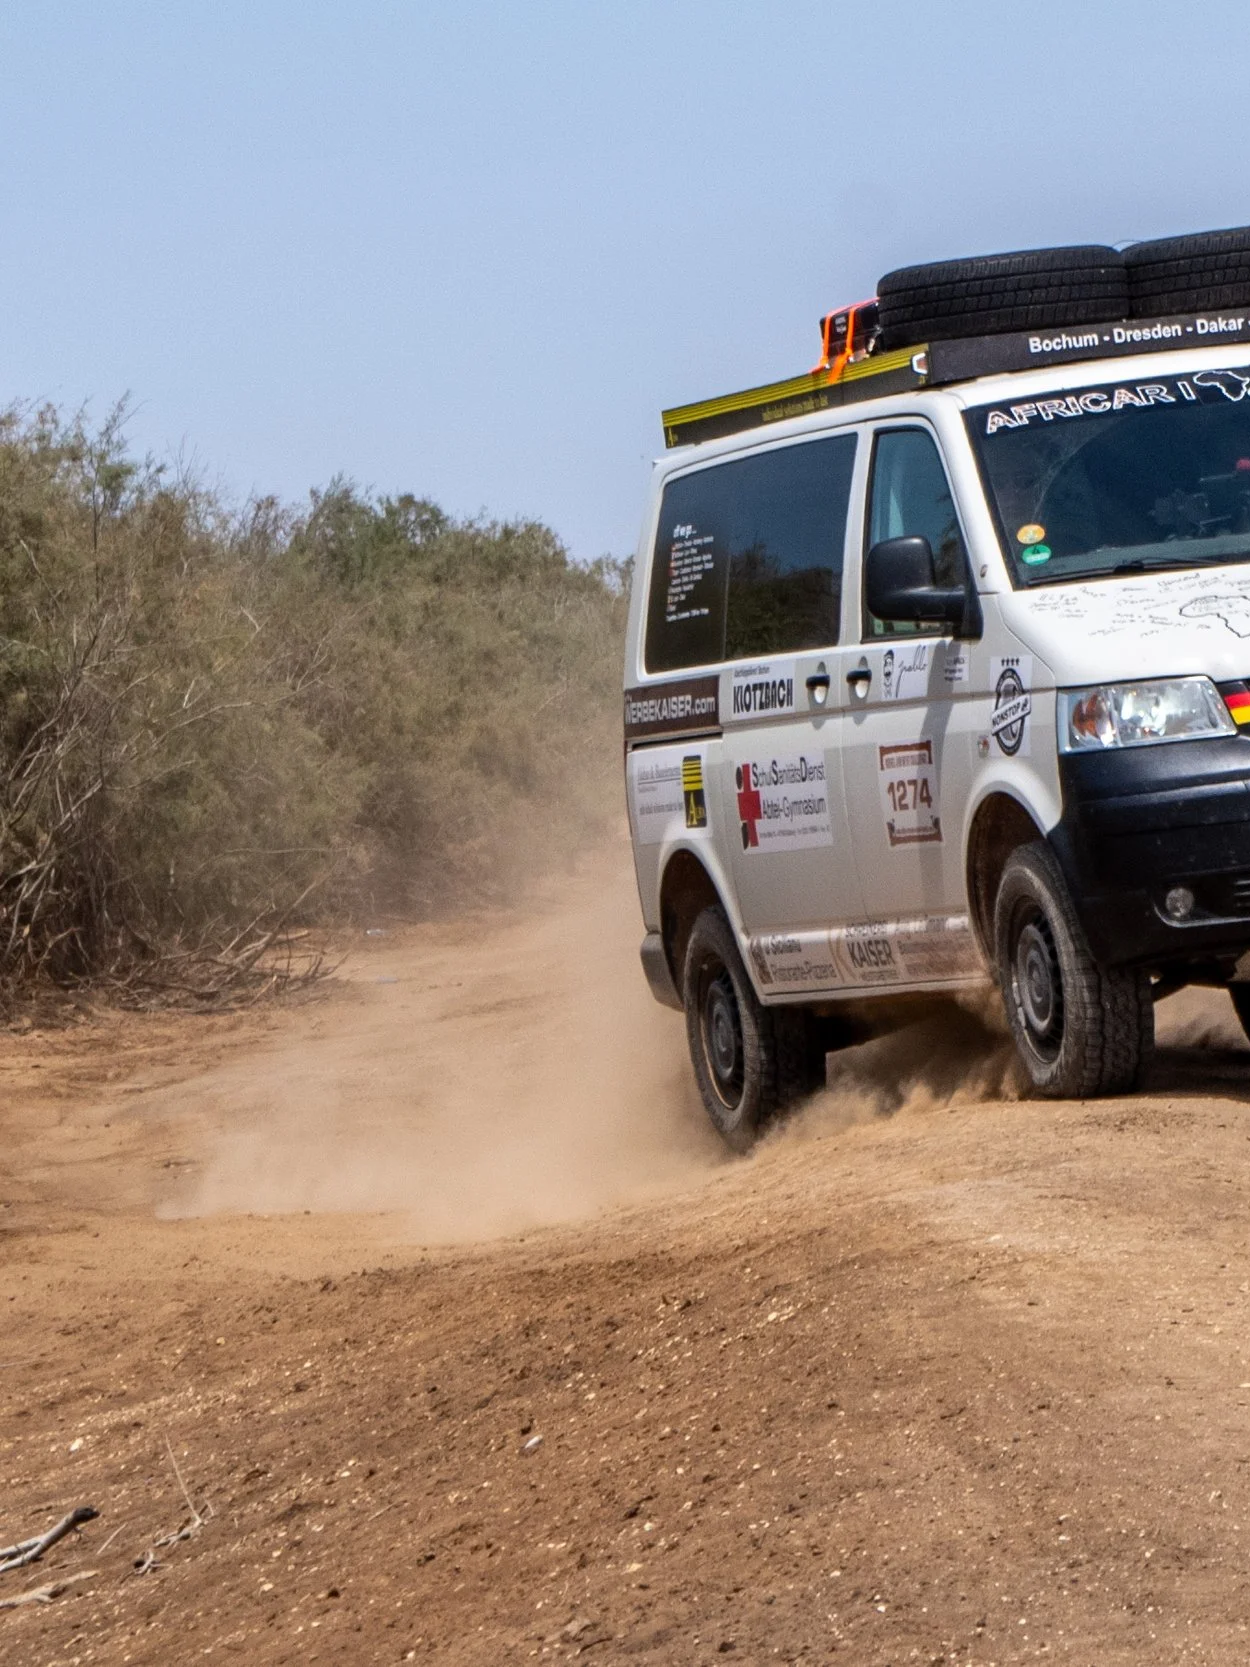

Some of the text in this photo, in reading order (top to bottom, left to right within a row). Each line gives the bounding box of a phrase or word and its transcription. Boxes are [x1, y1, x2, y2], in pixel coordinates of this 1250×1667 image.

[1029, 331, 1099, 353] Bochum
[1113, 323, 1182, 344] Dresden
[1196, 316, 1244, 335] Dakar
[986, 384, 1176, 434] AFRICAR
[733, 678, 793, 714] KLOTZBACH
[992, 702, 1021, 726] NONSTOP
[887, 778, 933, 812] 1274
[846, 939, 896, 968] KAISER
